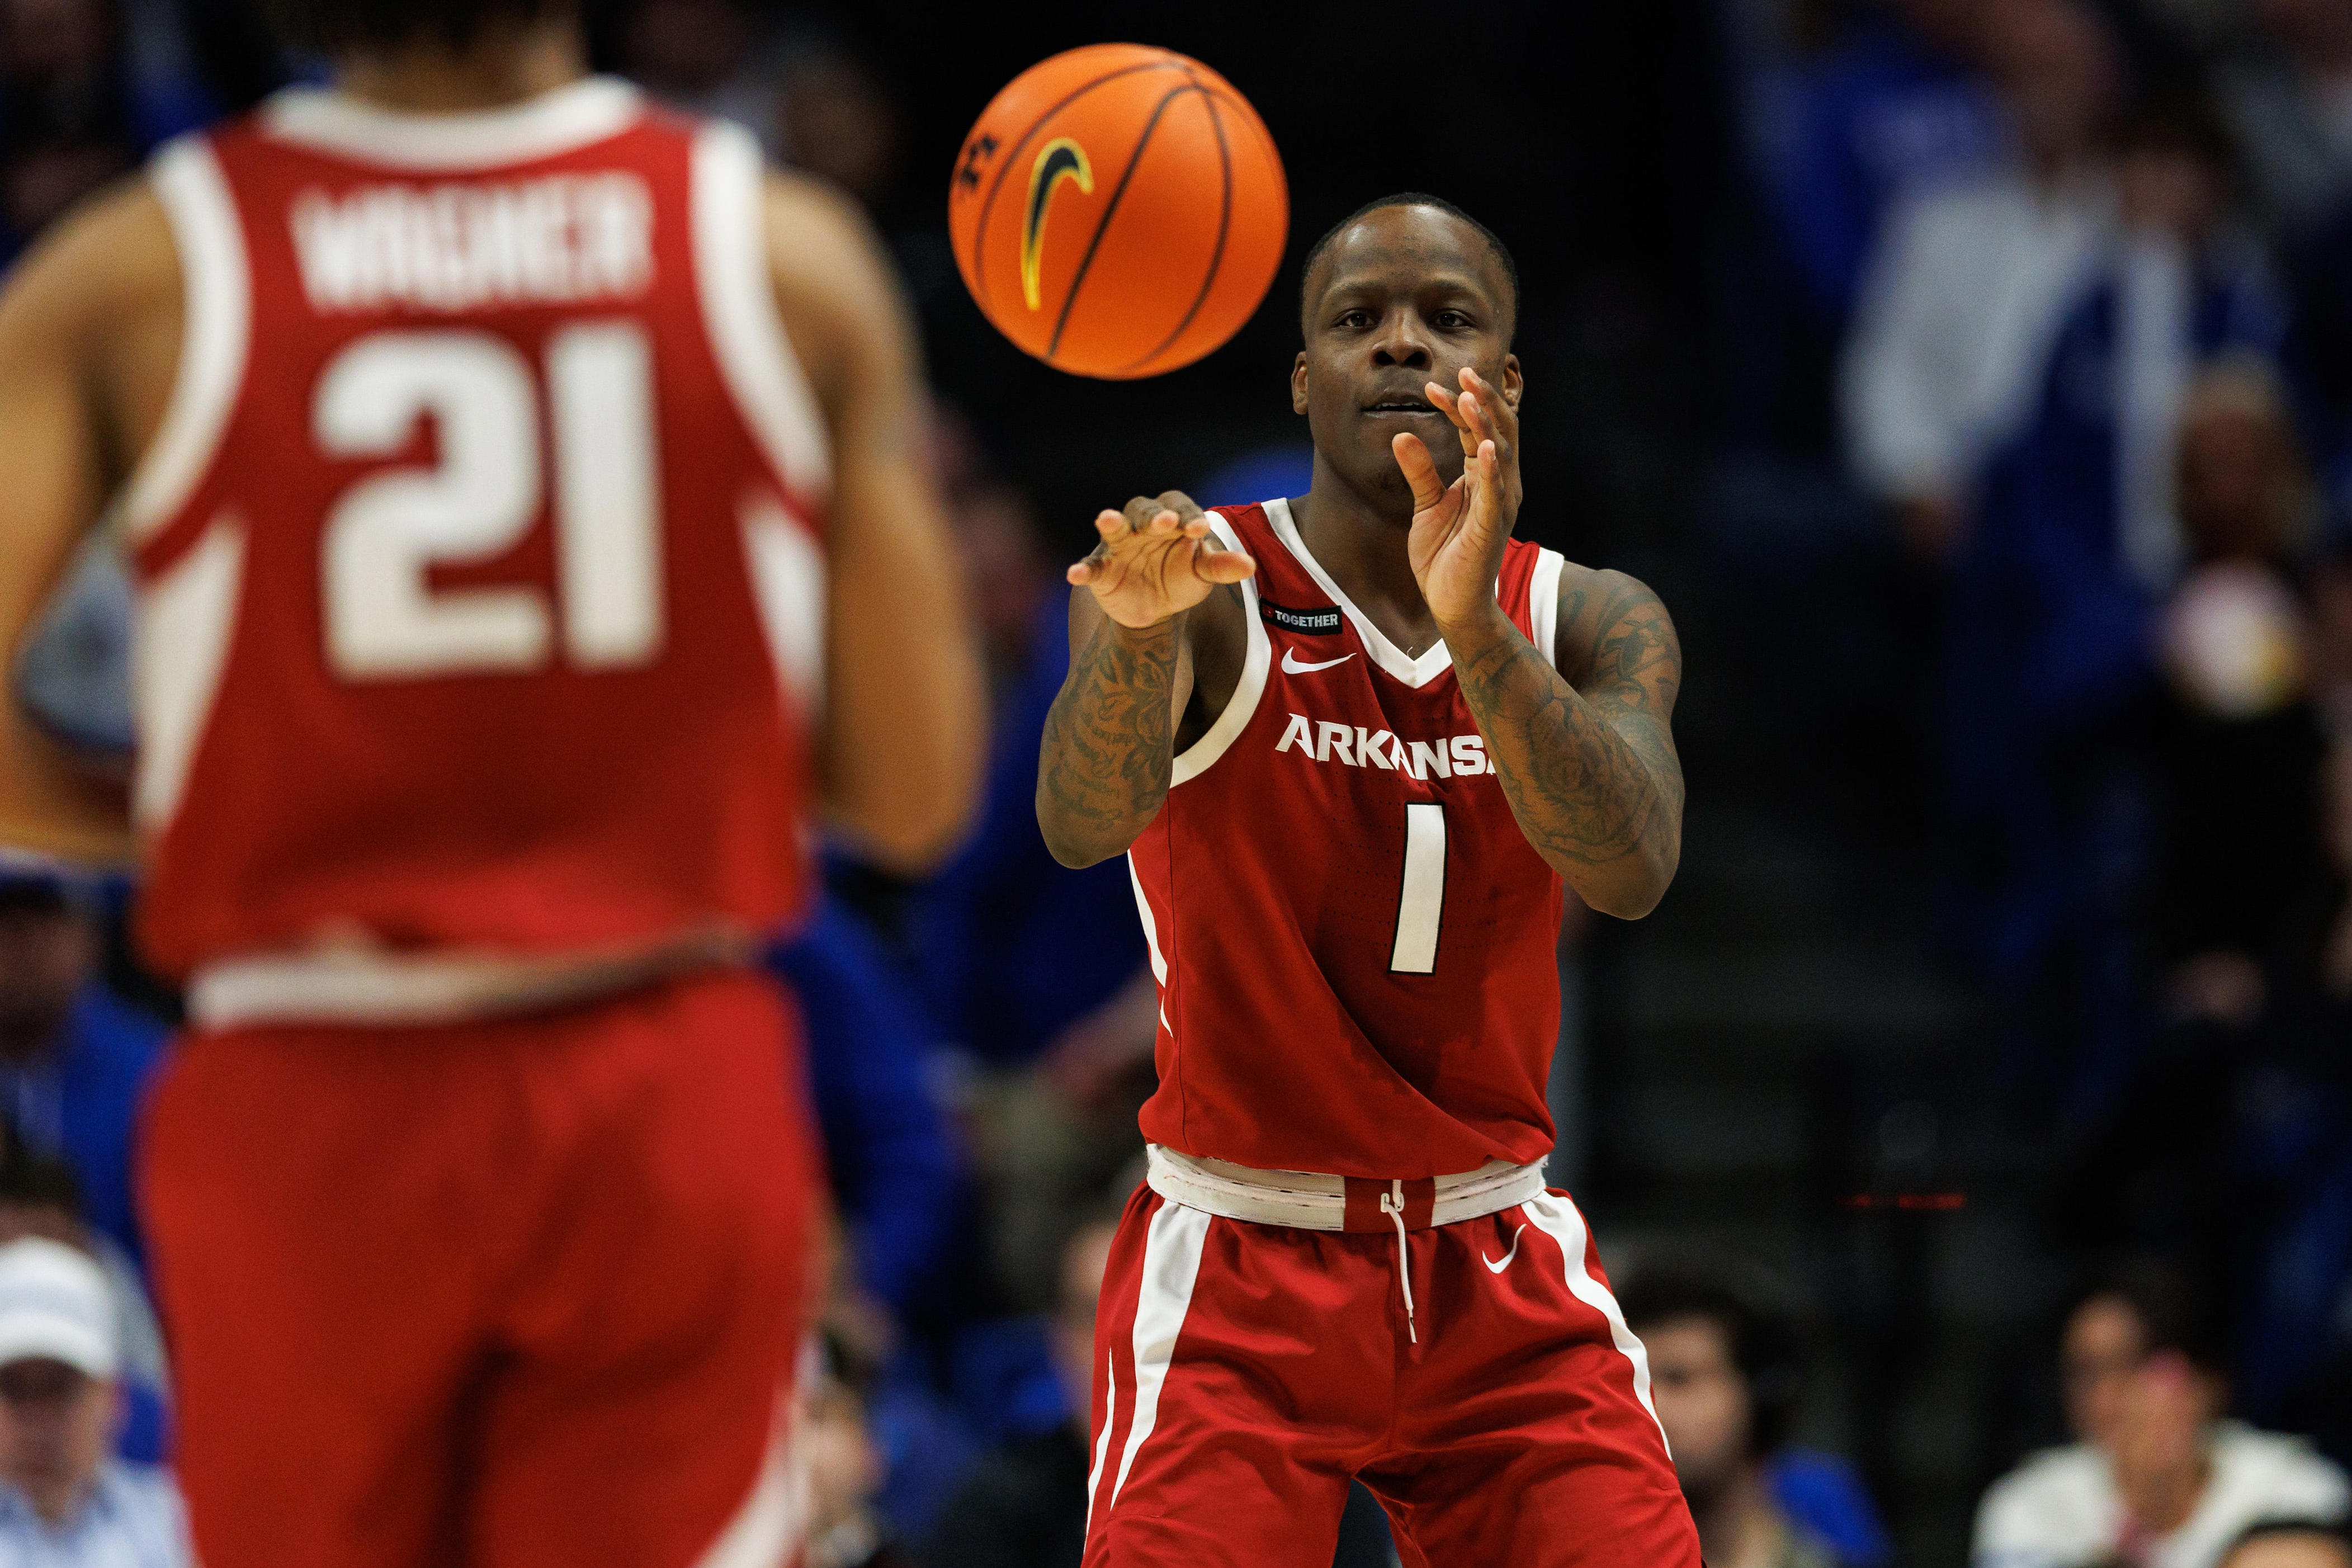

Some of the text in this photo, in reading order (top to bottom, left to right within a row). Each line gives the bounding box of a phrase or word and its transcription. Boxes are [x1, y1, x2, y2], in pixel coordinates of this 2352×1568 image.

[292, 176, 653, 311] WAGNER
[315, 327, 662, 680] 21
[1275, 610, 1338, 627] TOGETHER
[1274, 712, 1496, 780] ARKANS
[1387, 801, 1447, 976] 1
